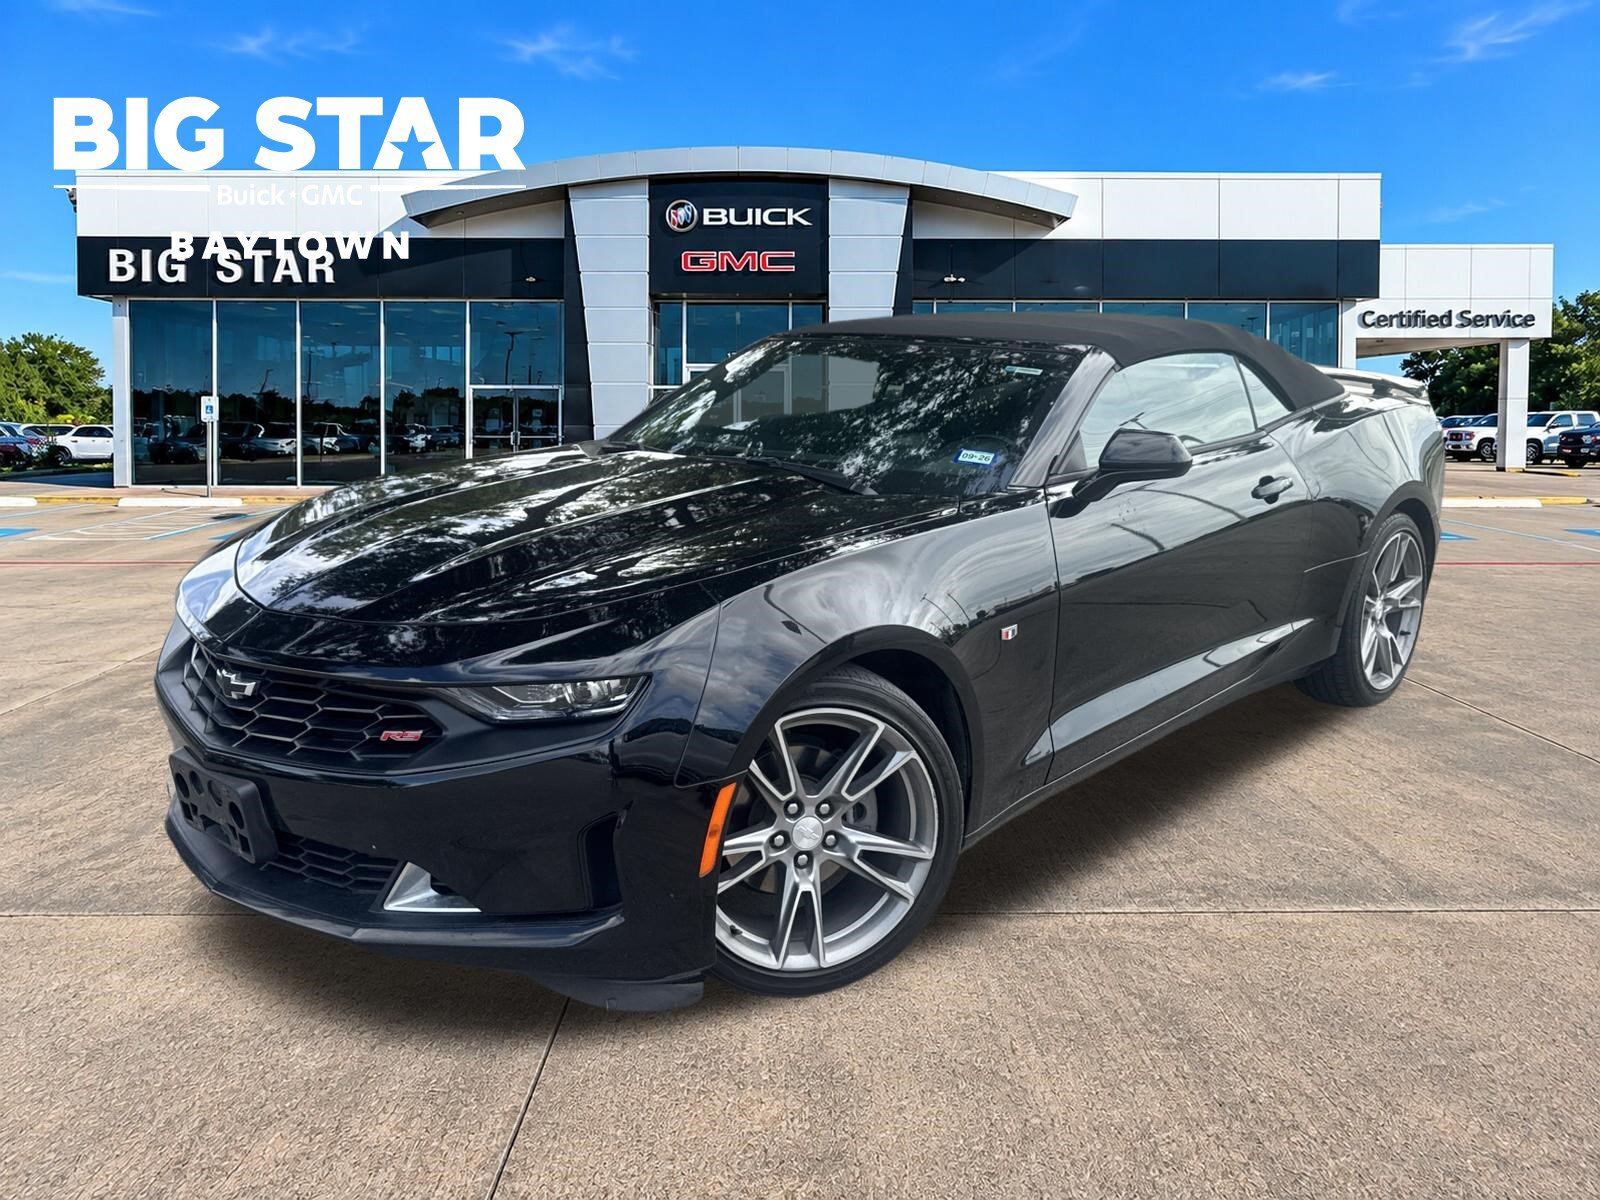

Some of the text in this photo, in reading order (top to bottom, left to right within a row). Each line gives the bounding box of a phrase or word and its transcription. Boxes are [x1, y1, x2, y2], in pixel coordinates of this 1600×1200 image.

[702, 207, 813, 227] BUICK
[108, 248, 336, 283] BIG STAR
[681, 250, 796, 272] GMC
[1359, 309, 1536, 329] Certified Service
[380, 730, 423, 741] RS
